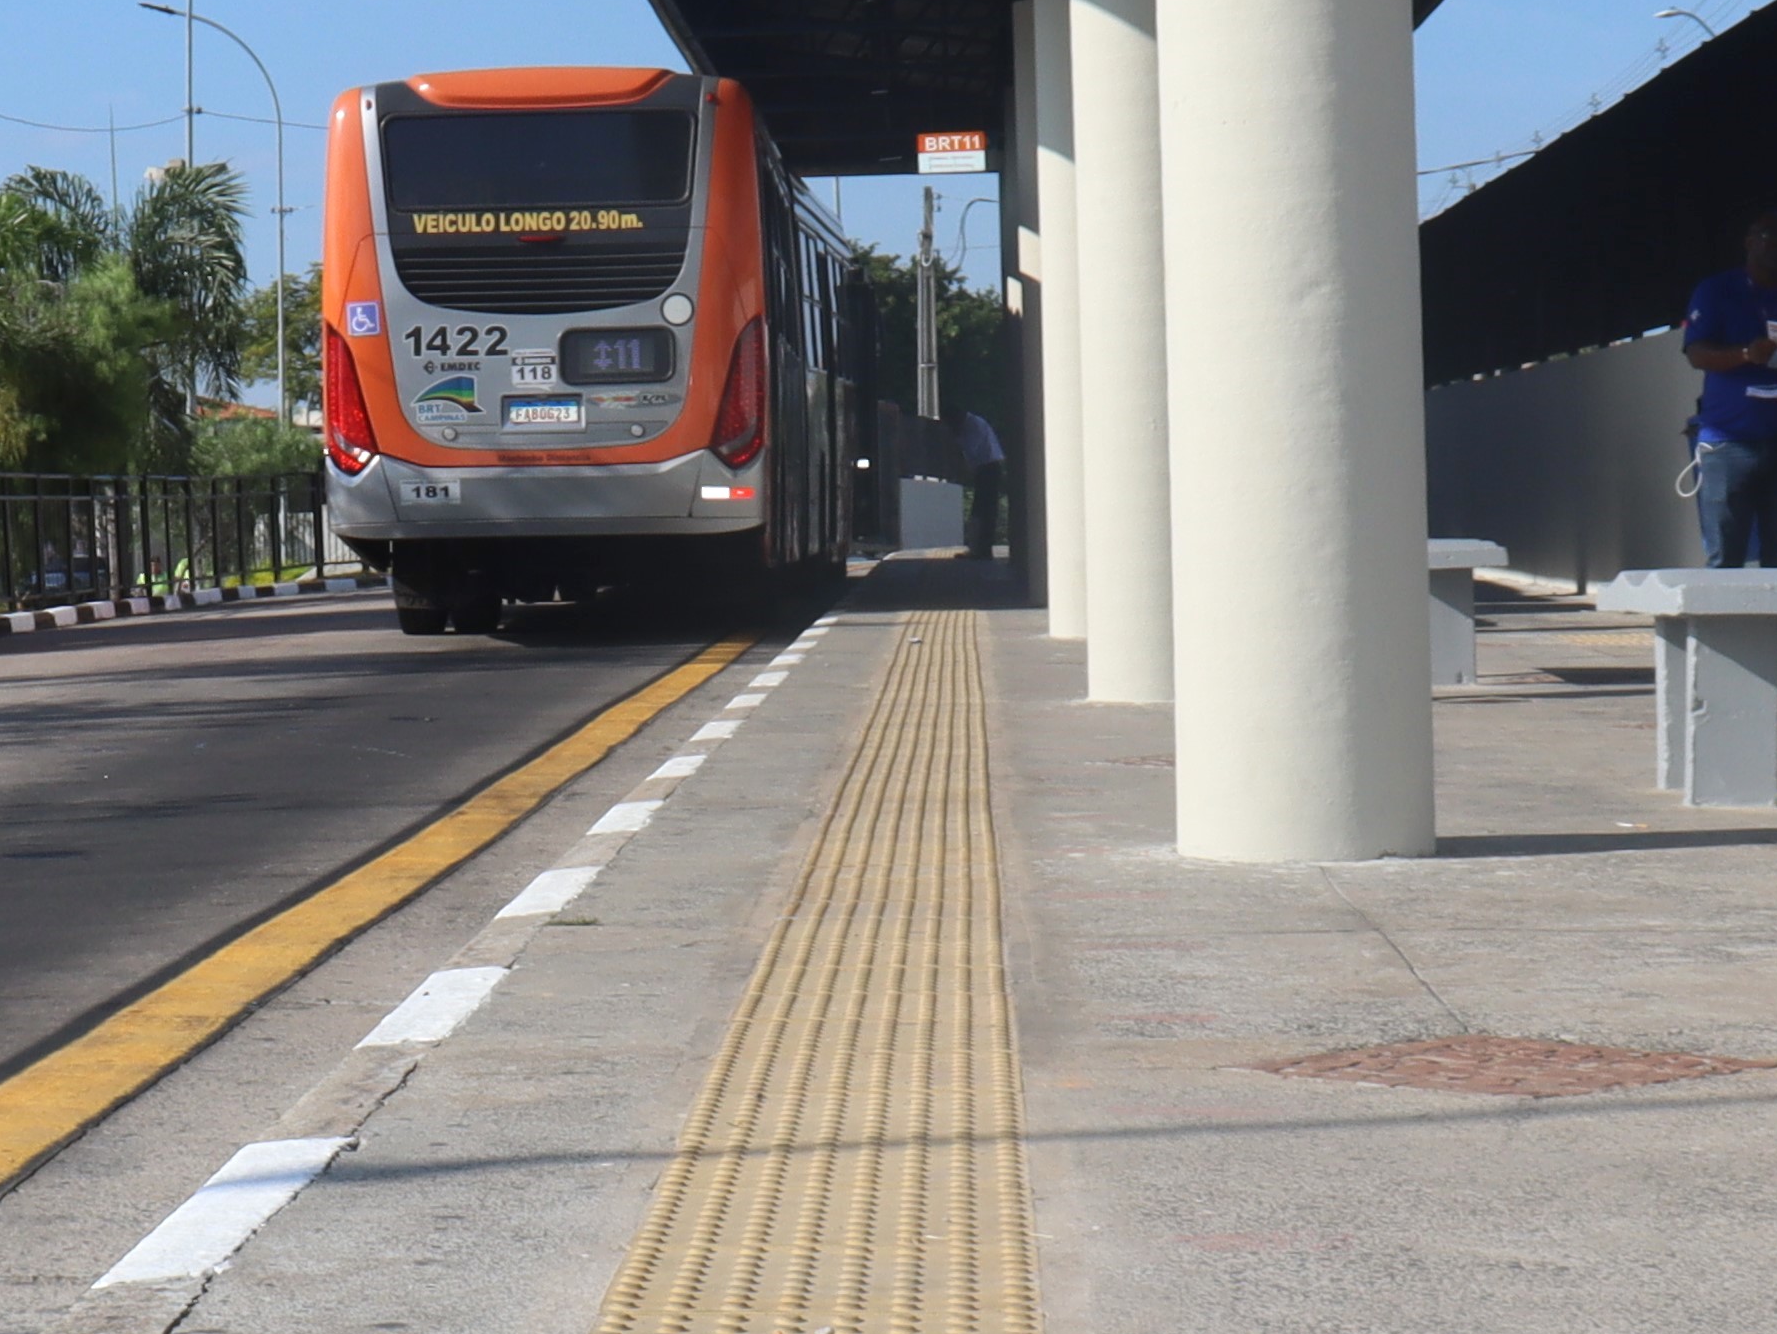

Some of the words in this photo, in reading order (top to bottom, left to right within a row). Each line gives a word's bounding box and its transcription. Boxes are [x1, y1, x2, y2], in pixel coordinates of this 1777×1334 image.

[925, 135, 980, 151] BRT11
[499, 212, 566, 232] LONGO
[404, 325, 509, 357] 1422
[516, 366, 552, 380] 118
[418, 404, 441, 414] BRT
[412, 485, 450, 498] 181
